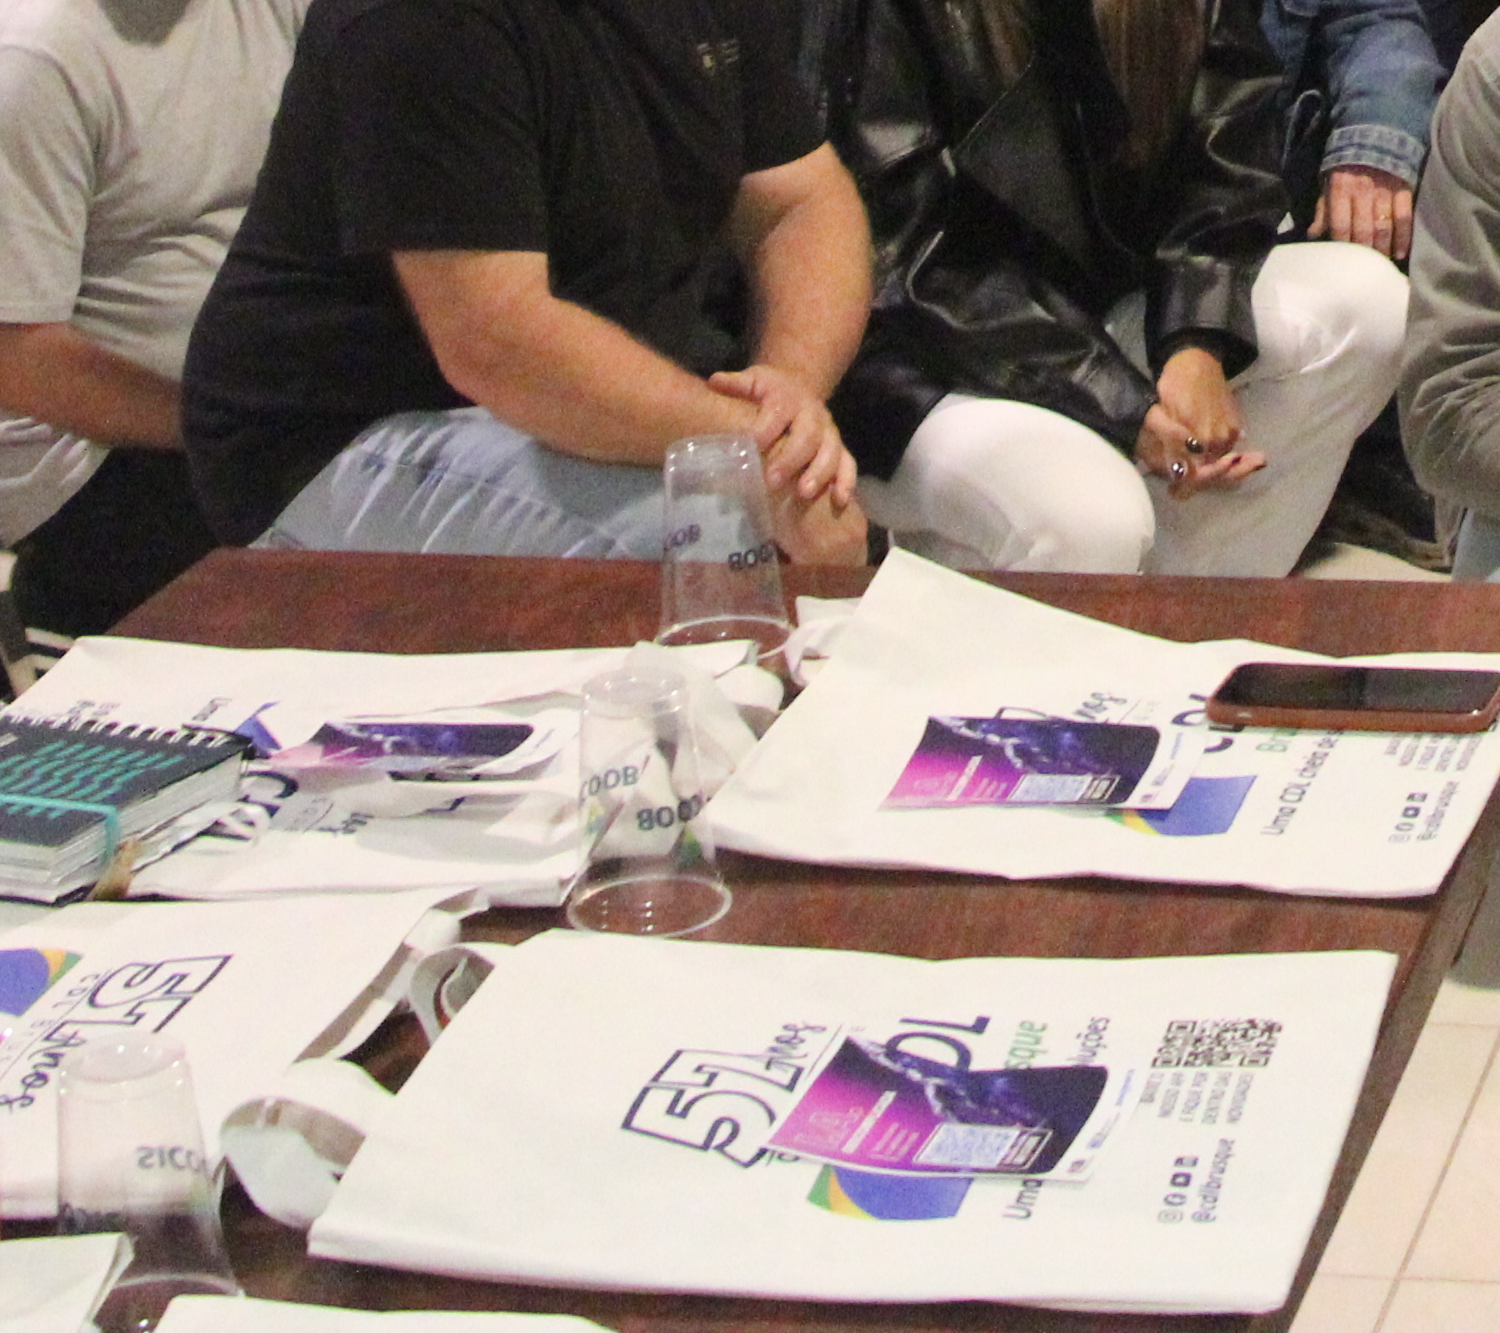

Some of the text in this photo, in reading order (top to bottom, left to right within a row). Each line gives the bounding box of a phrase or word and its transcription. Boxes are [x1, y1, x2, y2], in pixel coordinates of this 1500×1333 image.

[1296, 749, 1330, 781] cheia
[1278, 782, 1312, 805] CDL
[1260, 806, 1297, 836] Uma
[885, 1015, 992, 1073] DL
[1002, 1020, 1049, 1070] sque
[1066, 1016, 1112, 1066] luções
[1191, 1137, 1236, 1223] @cdlbrusque
